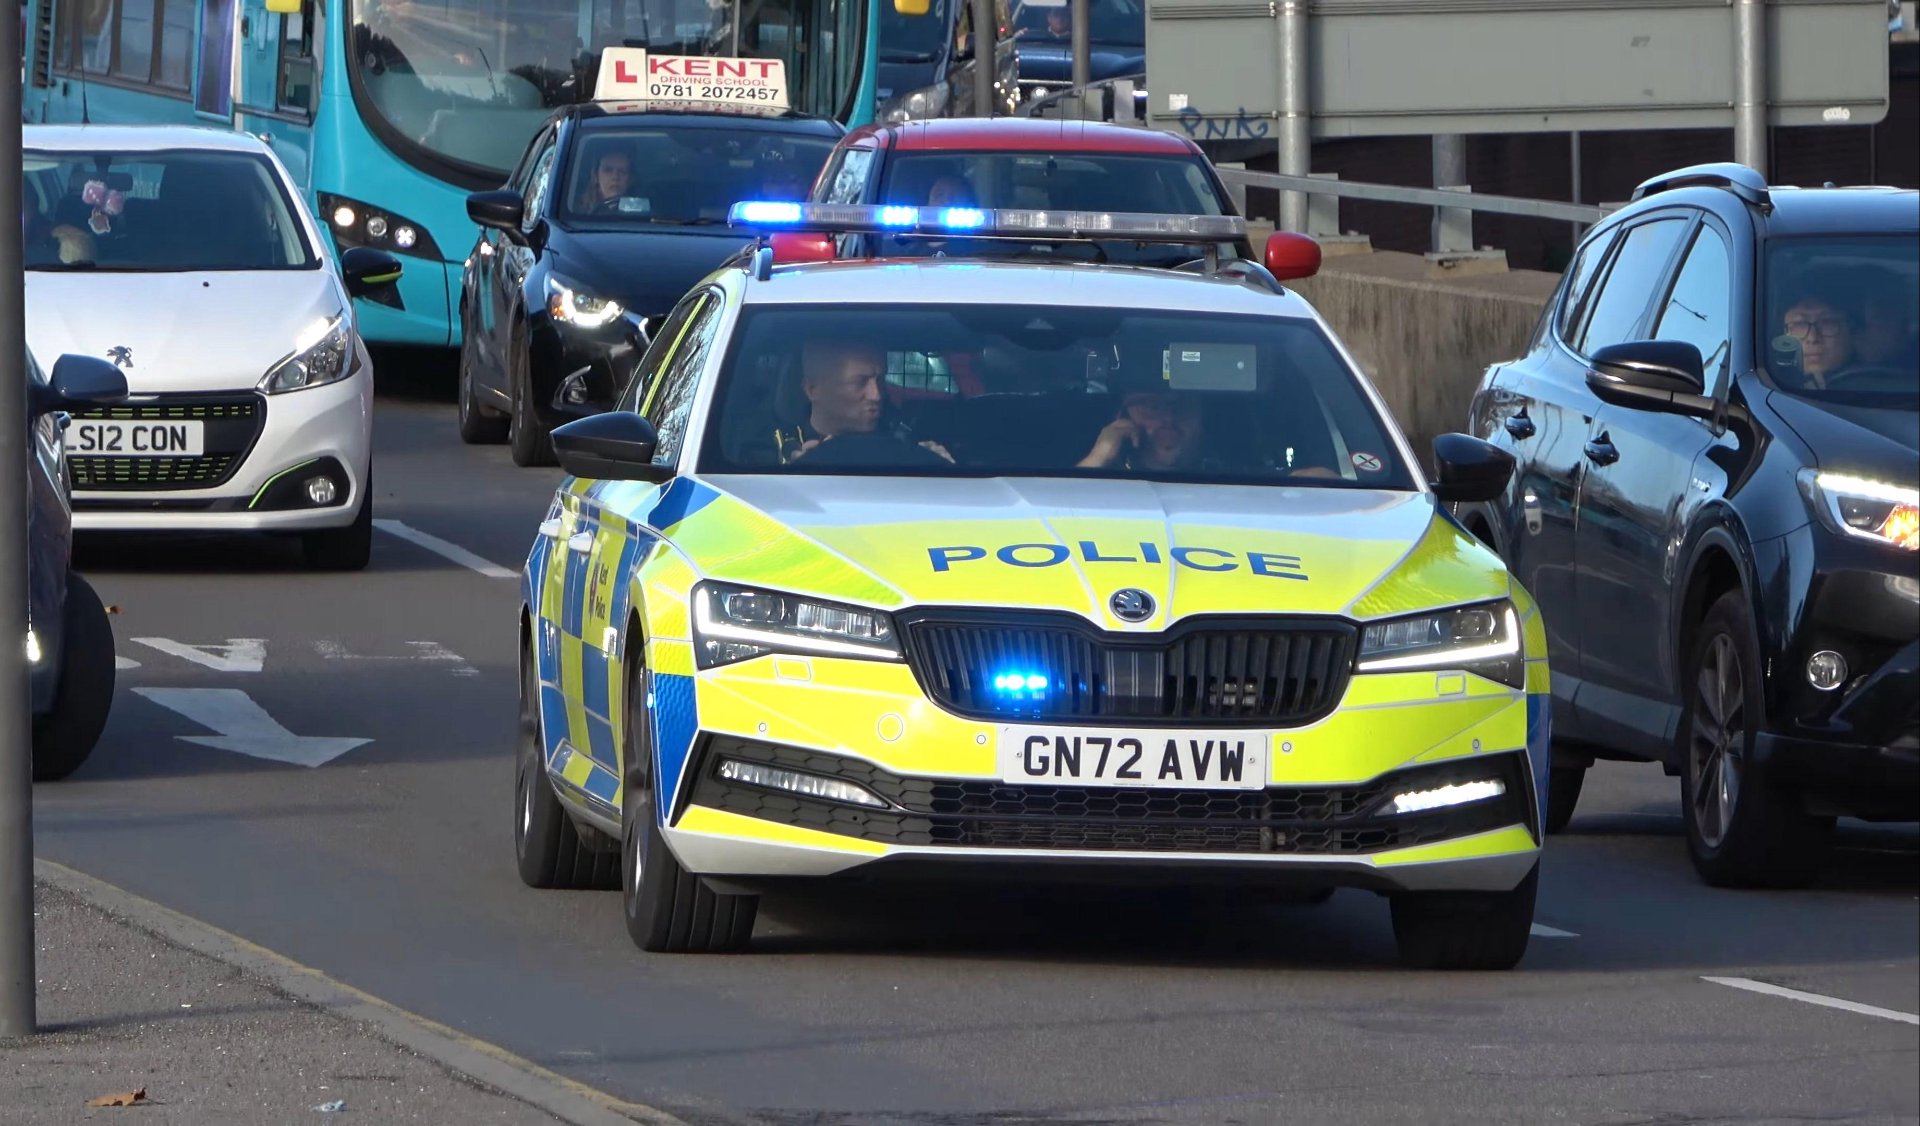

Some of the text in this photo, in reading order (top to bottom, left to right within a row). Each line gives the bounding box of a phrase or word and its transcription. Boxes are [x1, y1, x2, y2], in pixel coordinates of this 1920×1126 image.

[615, 60, 638, 84] L
[649, 57, 780, 79] KENT
[650, 83, 780, 101] 0781 2072457
[660, 75, 768, 87] DRIVING SCHOOL
[131, 425, 188, 452] CON
[926, 540, 1310, 582] POLICE
[1022, 735, 1246, 782] GN72 AVW
